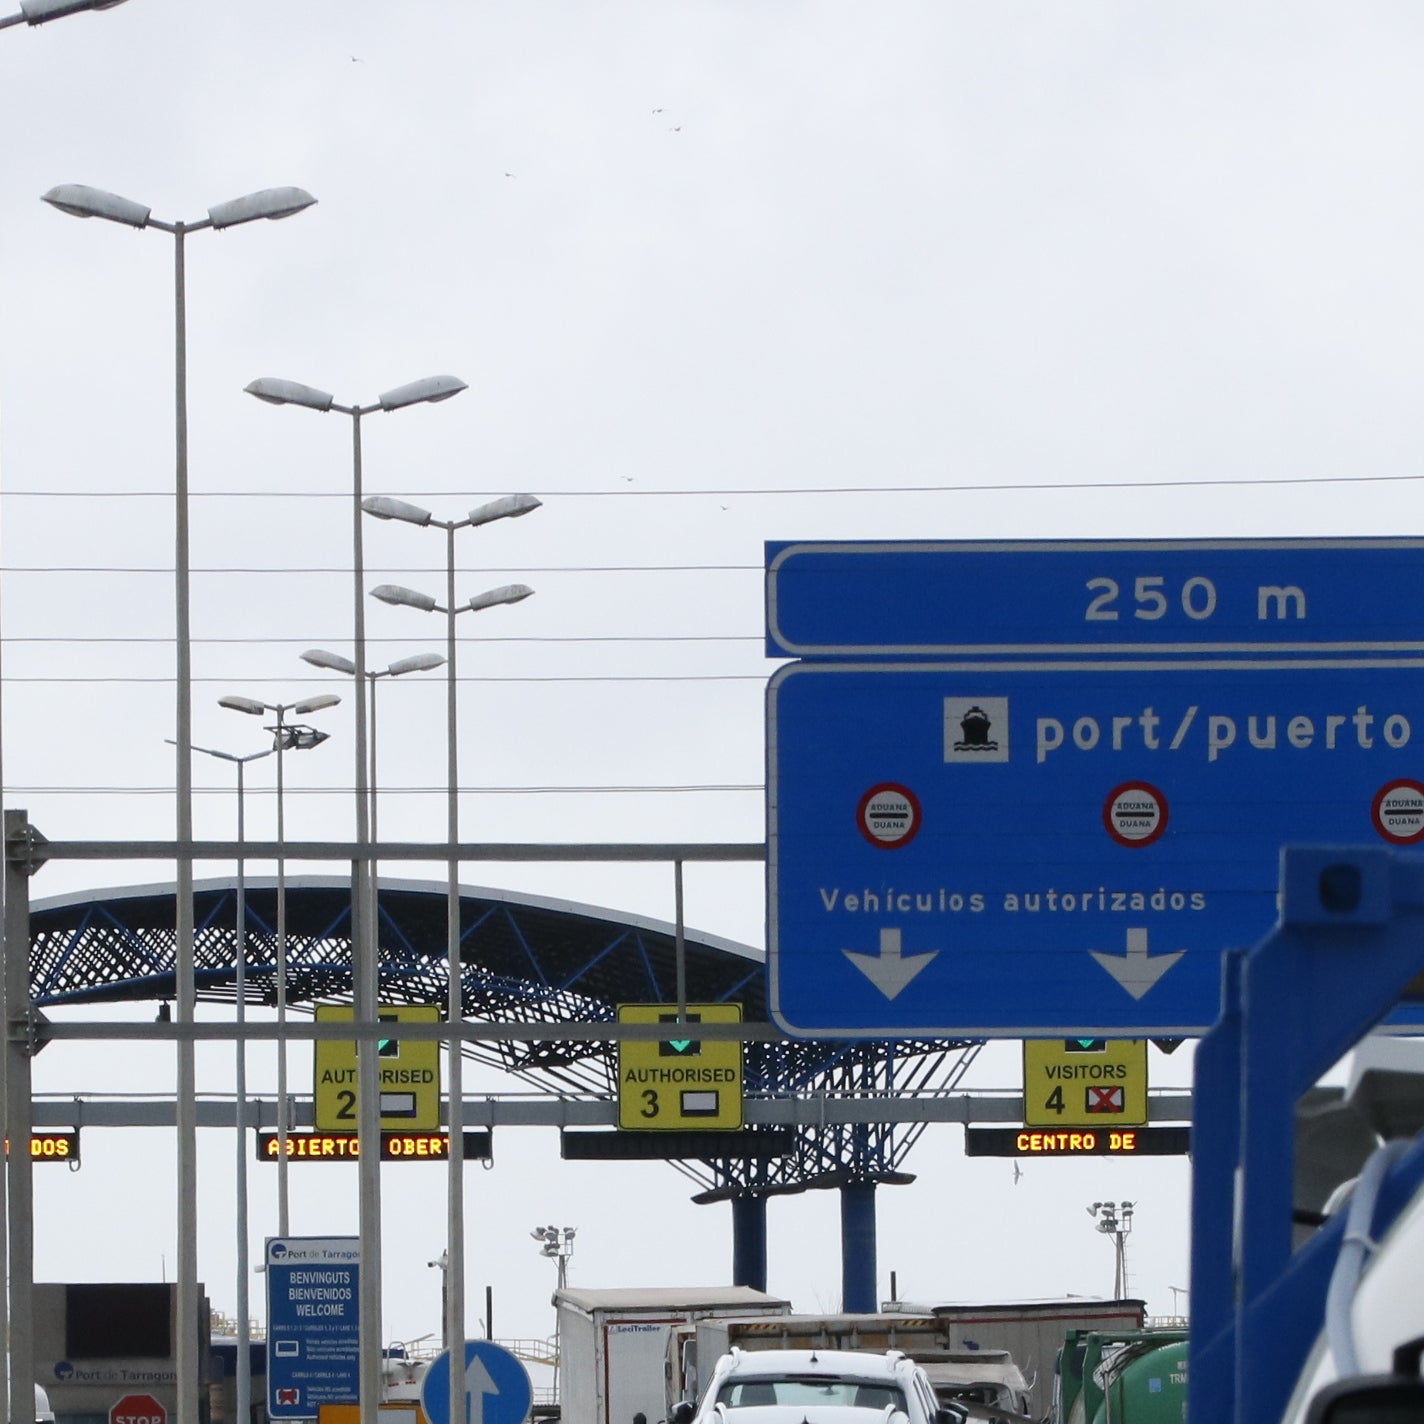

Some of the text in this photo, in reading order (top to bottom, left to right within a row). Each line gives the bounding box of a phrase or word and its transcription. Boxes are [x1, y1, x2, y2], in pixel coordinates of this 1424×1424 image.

[1083, 575, 1307, 621] 250 m
[1035, 705, 1412, 763] port/puerto
[870, 803, 908, 812] ADUANA
[1116, 802, 1154, 810] ADUANA
[1385, 800, 1423, 808] ADUANA
[874, 821, 905, 829] DUANA
[1119, 820, 1151, 828] DUANA
[1388, 817, 1420, 826] DUANA
[819, 886, 1207, 913] Vehículos autorizados
[321, 1069, 434, 1085] AUTRISED
[625, 1068, 736, 1083] AUTHORISED
[1044, 1064, 1126, 1079] VISITORS
[336, 1090, 356, 1120] 2
[640, 1090, 660, 1118] 3
[1044, 1085, 1066, 1115] 4
[1017, 1133, 1136, 1151] CENTRO DE
[288, 1249, 307, 1258] Port
[289, 1271, 351, 1285] BENVINGUTS
[288, 1287, 352, 1301] BIENVENIDOS
[296, 1303, 345, 1317] WELCOME
[76, 1369, 100, 1381] Port
